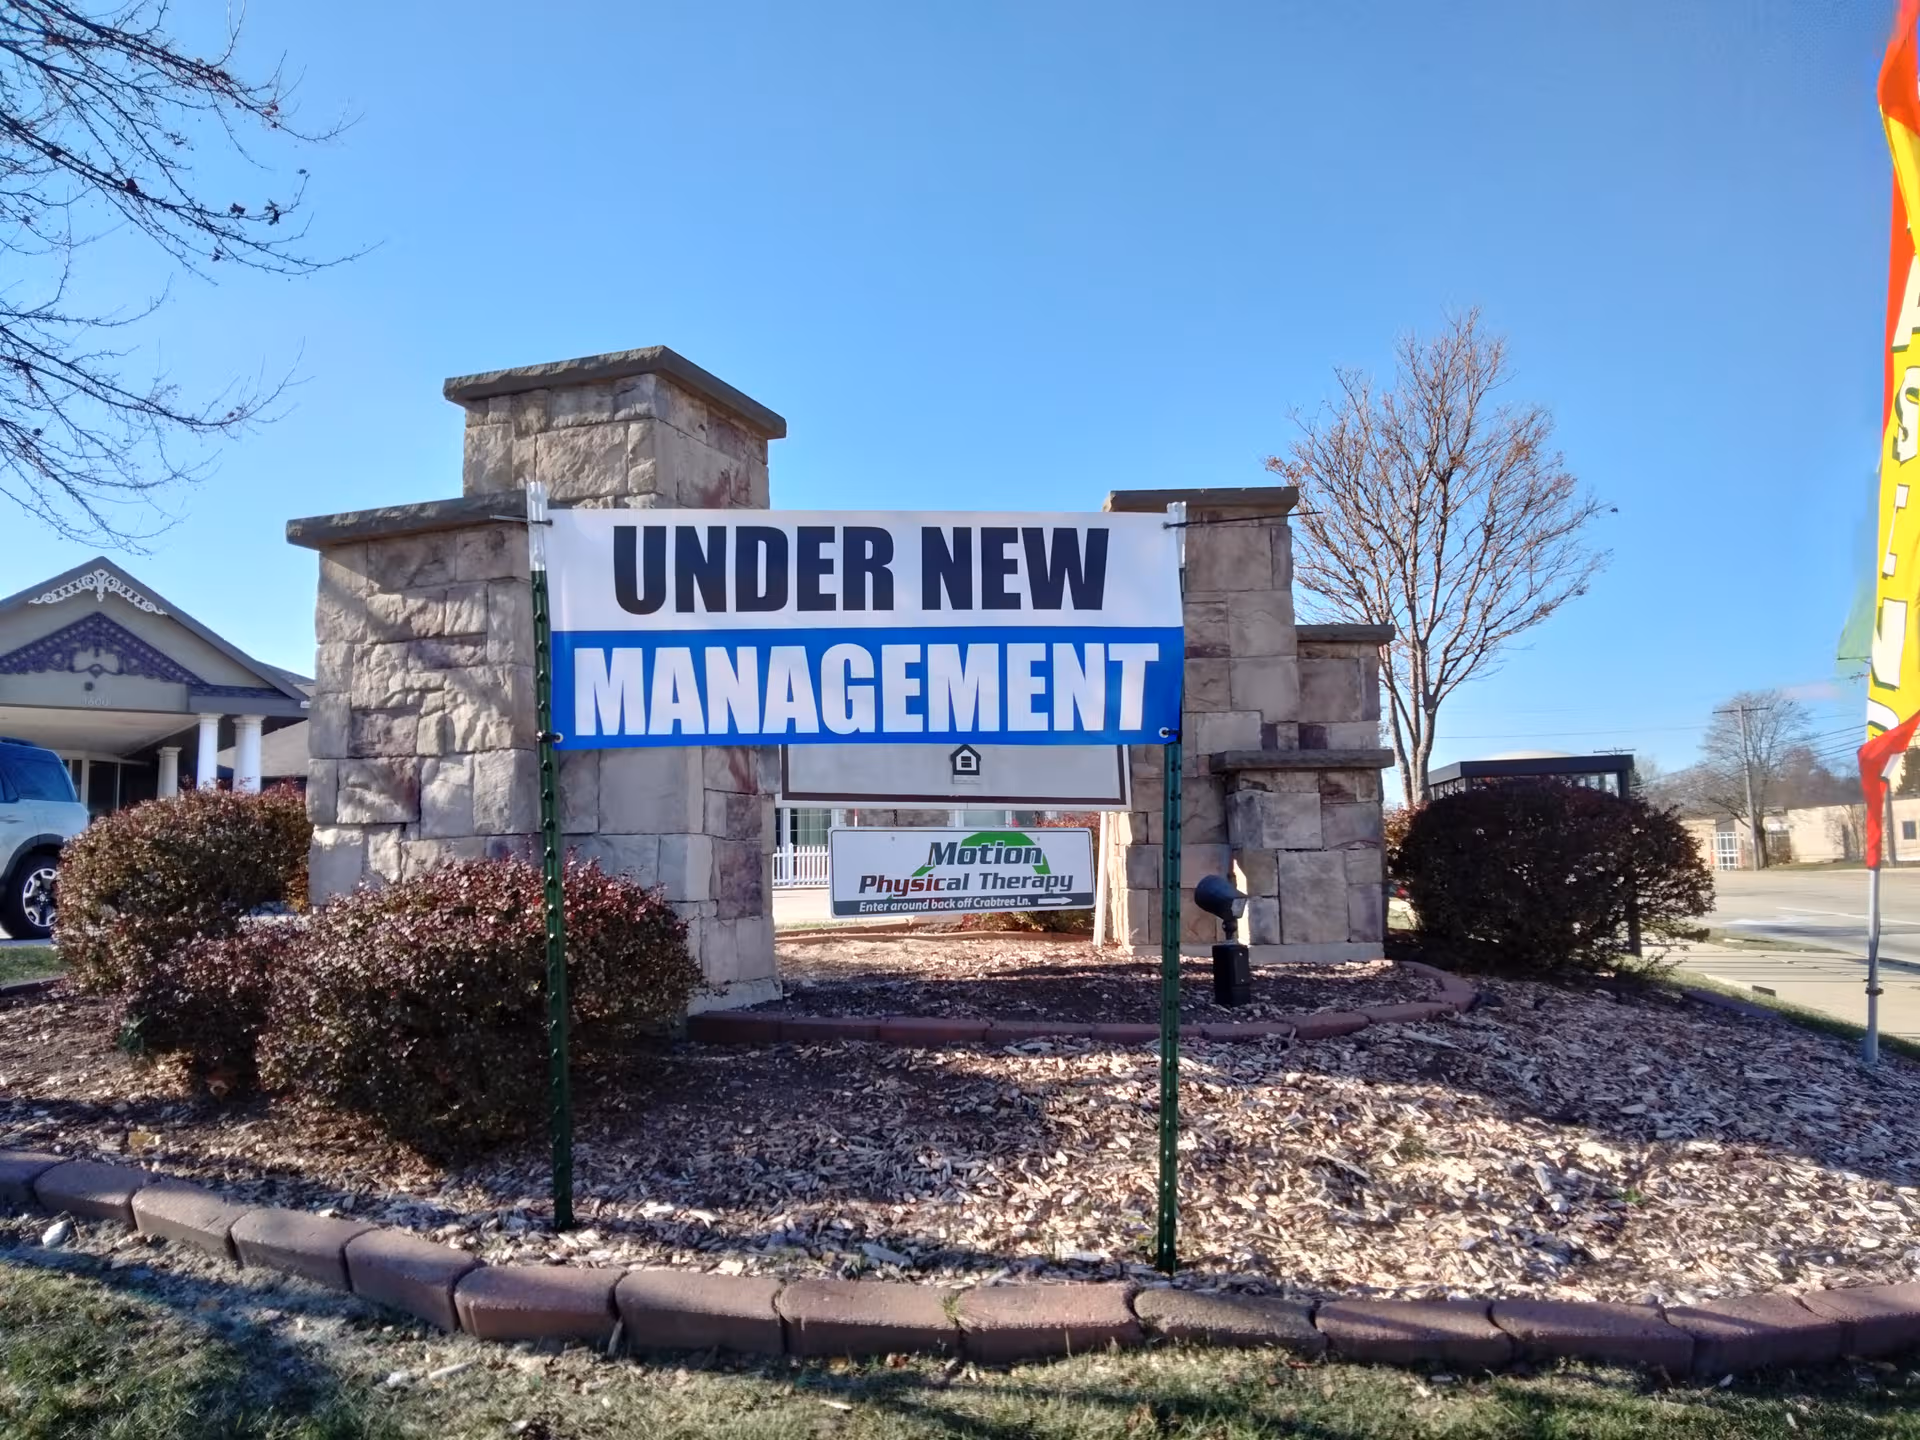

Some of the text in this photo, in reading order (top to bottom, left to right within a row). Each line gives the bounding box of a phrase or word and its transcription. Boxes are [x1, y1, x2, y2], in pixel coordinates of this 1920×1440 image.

[613, 525, 1109, 615] UNDER NEW
[573, 643, 1159, 736] MANAGEMENT
[927, 841, 1043, 866] Motion
[858, 872, 1074, 897] Physical Therapy
[859, 896, 1031, 913] Enter around back off Crabtree Ln.
